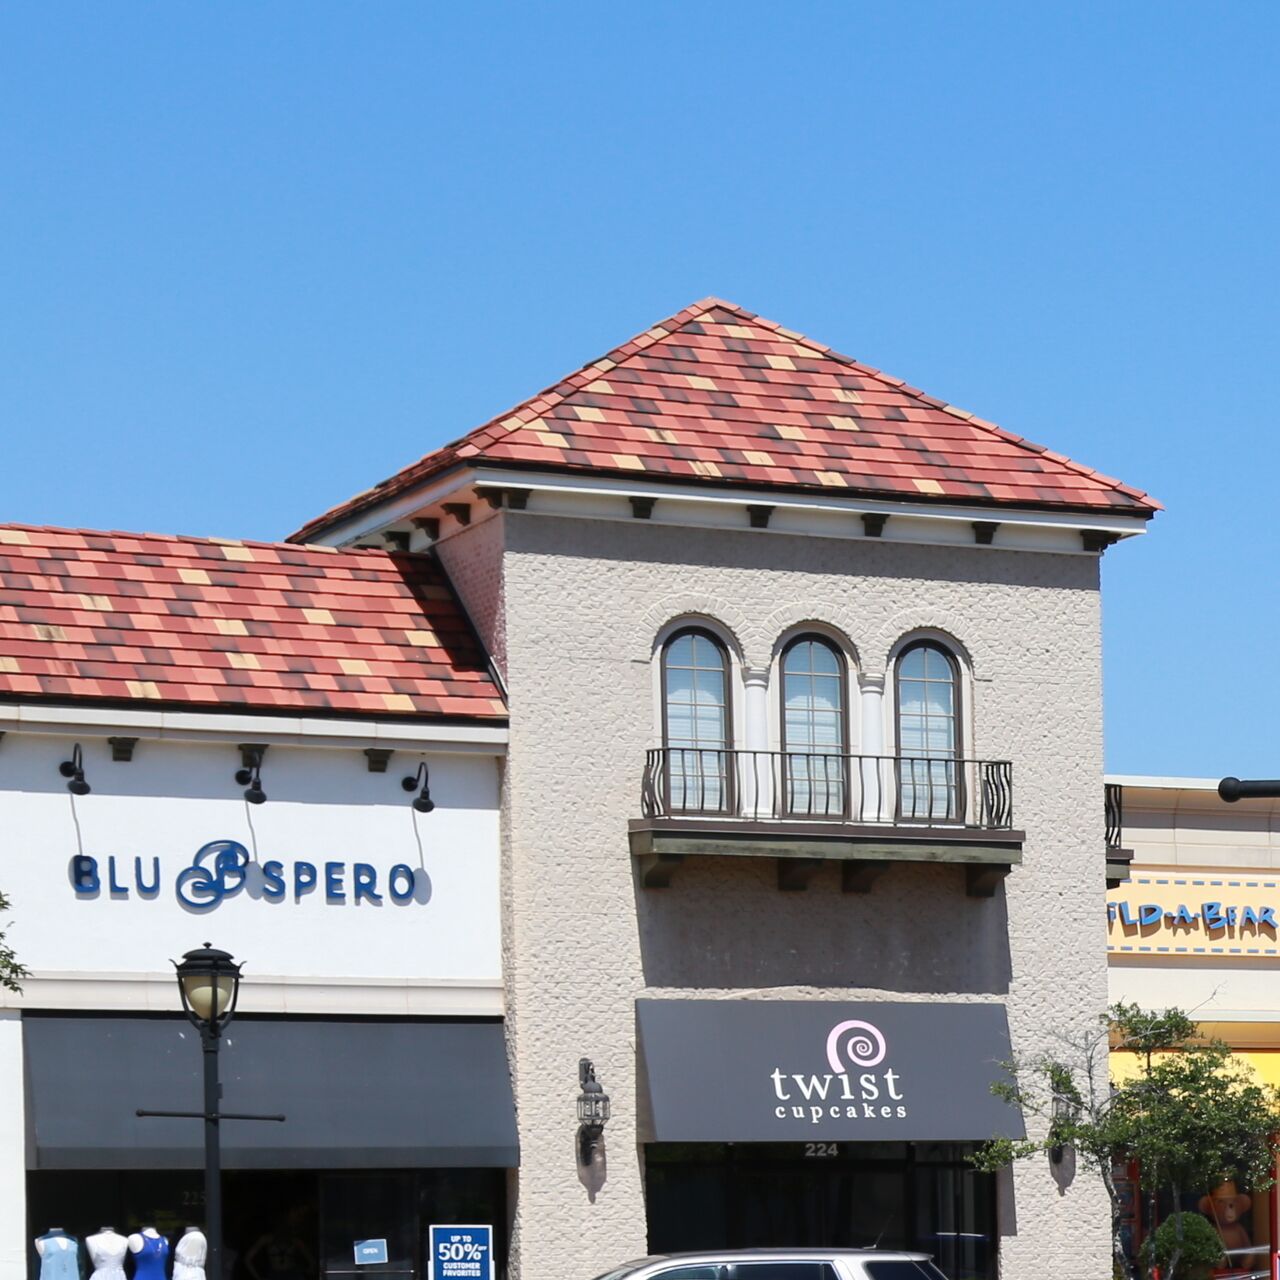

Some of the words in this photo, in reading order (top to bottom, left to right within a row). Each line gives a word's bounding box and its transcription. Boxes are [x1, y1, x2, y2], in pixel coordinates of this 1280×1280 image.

[74, 855, 160, 895] BLU
[262, 859, 415, 900] SPERO
[770, 1067, 904, 1101] twist
[775, 1103, 907, 1124] cupcakes
[804, 1143, 839, 1157] 224
[450, 1235, 461, 1243] UP
[463, 1235, 472, 1243] TO
[438, 1243, 482, 1261] 50%
[443, 1262, 481, 1270] CUSTOMER
[443, 1269, 481, 1277] FAVORITES
